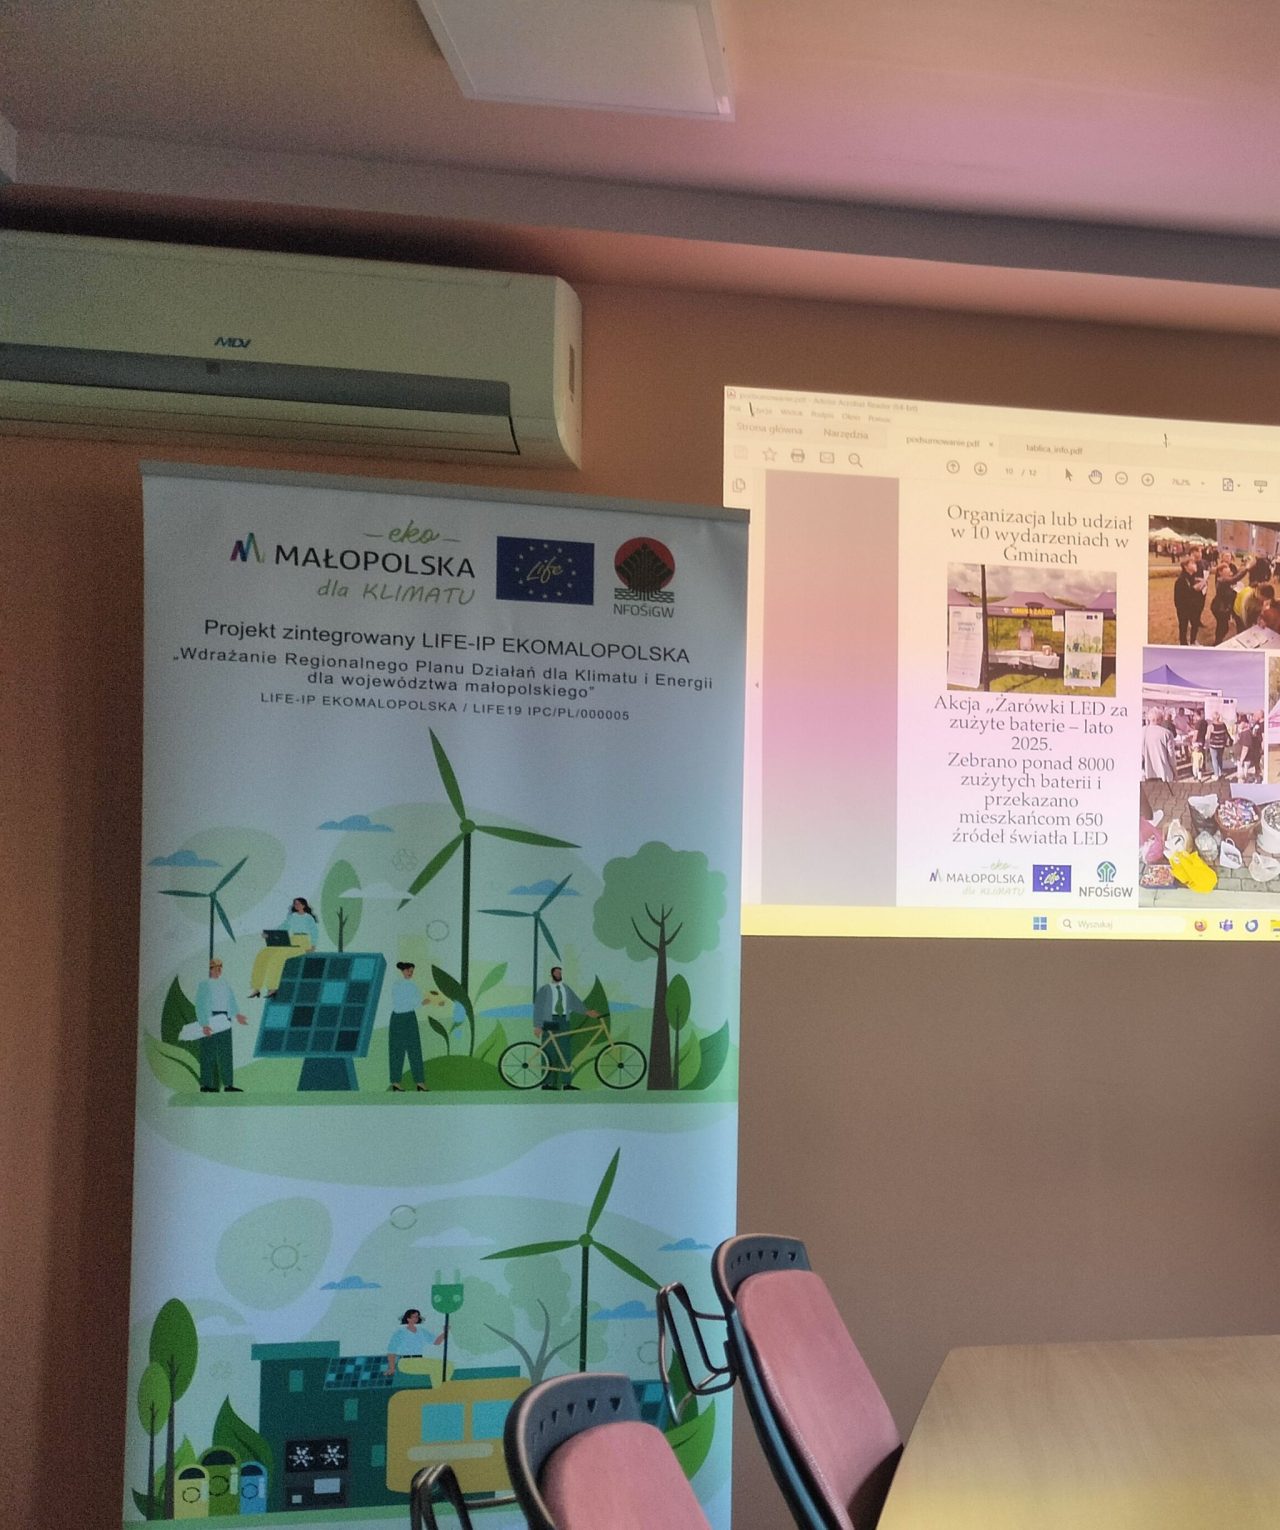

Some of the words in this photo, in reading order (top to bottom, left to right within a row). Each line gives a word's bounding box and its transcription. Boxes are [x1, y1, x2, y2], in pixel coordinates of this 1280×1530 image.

[214, 336, 251, 349] MDV
[737, 422, 766, 433] Strona
[769, 423, 803, 438] główna
[823, 428, 869, 440] Narzędzia
[906, 435, 980, 449] podsumowanie.pdf
[947, 504, 1047, 529] Organizacja
[1051, 511, 1077, 526] lub
[1082, 514, 1132, 531] udział
[388, 520, 440, 544] eko
[951, 528, 966, 539] w
[972, 526, 990, 540] 10
[995, 528, 1109, 551] wydarzeniach
[1115, 538, 1129, 549] w
[275, 544, 476, 579] MAŁOPOLSKA
[1003, 547, 1078, 565] Gminach
[526, 556, 564, 584] Life
[317, 579, 350, 599] dla
[362, 583, 476, 605] KLIMATU
[613, 602, 675, 619] NFOŚiGW
[204, 619, 276, 640] Projekt
[282, 625, 416, 650] zintegrowany
[422, 633, 495, 652] LIFE-IP
[502, 637, 690, 663] EKOMALOPOLSKA
[173, 647, 277, 664] „Wdrażanie
[285, 652, 408, 673] Regionalnego
[416, 660, 464, 675] Planu
[472, 663, 535, 679] Działań
[543, 668, 568, 681] dla
[575, 669, 637, 685] Klimatu
[644, 673, 649, 685] i
[655, 673, 713, 692] Energii
[307, 672, 334, 685] dla
[341, 674, 458, 691] województwa
[260, 692, 316, 705] LIFE-IP
[322, 696, 457, 713] EKOMALOPOLSKA
[473, 704, 522, 716] LIFE19
[528, 706, 630, 721] IPC/PL/000005
[934, 695, 980, 716] Akcja
[986, 693, 1065, 715] „Żarówki
[1070, 701, 1105, 717] LED
[1110, 705, 1128, 717] za
[949, 717, 1005, 734] zużyte
[1010, 717, 1065, 733] baterie
[1084, 719, 1114, 735] lato
[1011, 736, 1053, 751] 2025.
[947, 752, 1018, 769] Zebrano
[1022, 756, 1073, 774] ponad
[1077, 757, 1115, 772] 8000
[960, 772, 1035, 792] zużytych
[1040, 773, 1092, 789] baterii
[1097, 776, 1102, 790] i
[984, 792, 1079, 810] przekazano
[959, 810, 1071, 826] mieszkańcom
[1075, 812, 1103, 827] 650
[952, 828, 1005, 844] źródeł
[1009, 829, 1067, 845] światła
[1072, 831, 1108, 846] LED
[946, 873, 1025, 884] MAŁOPOLSKA
[1079, 884, 1134, 898] NFOŚiGW
